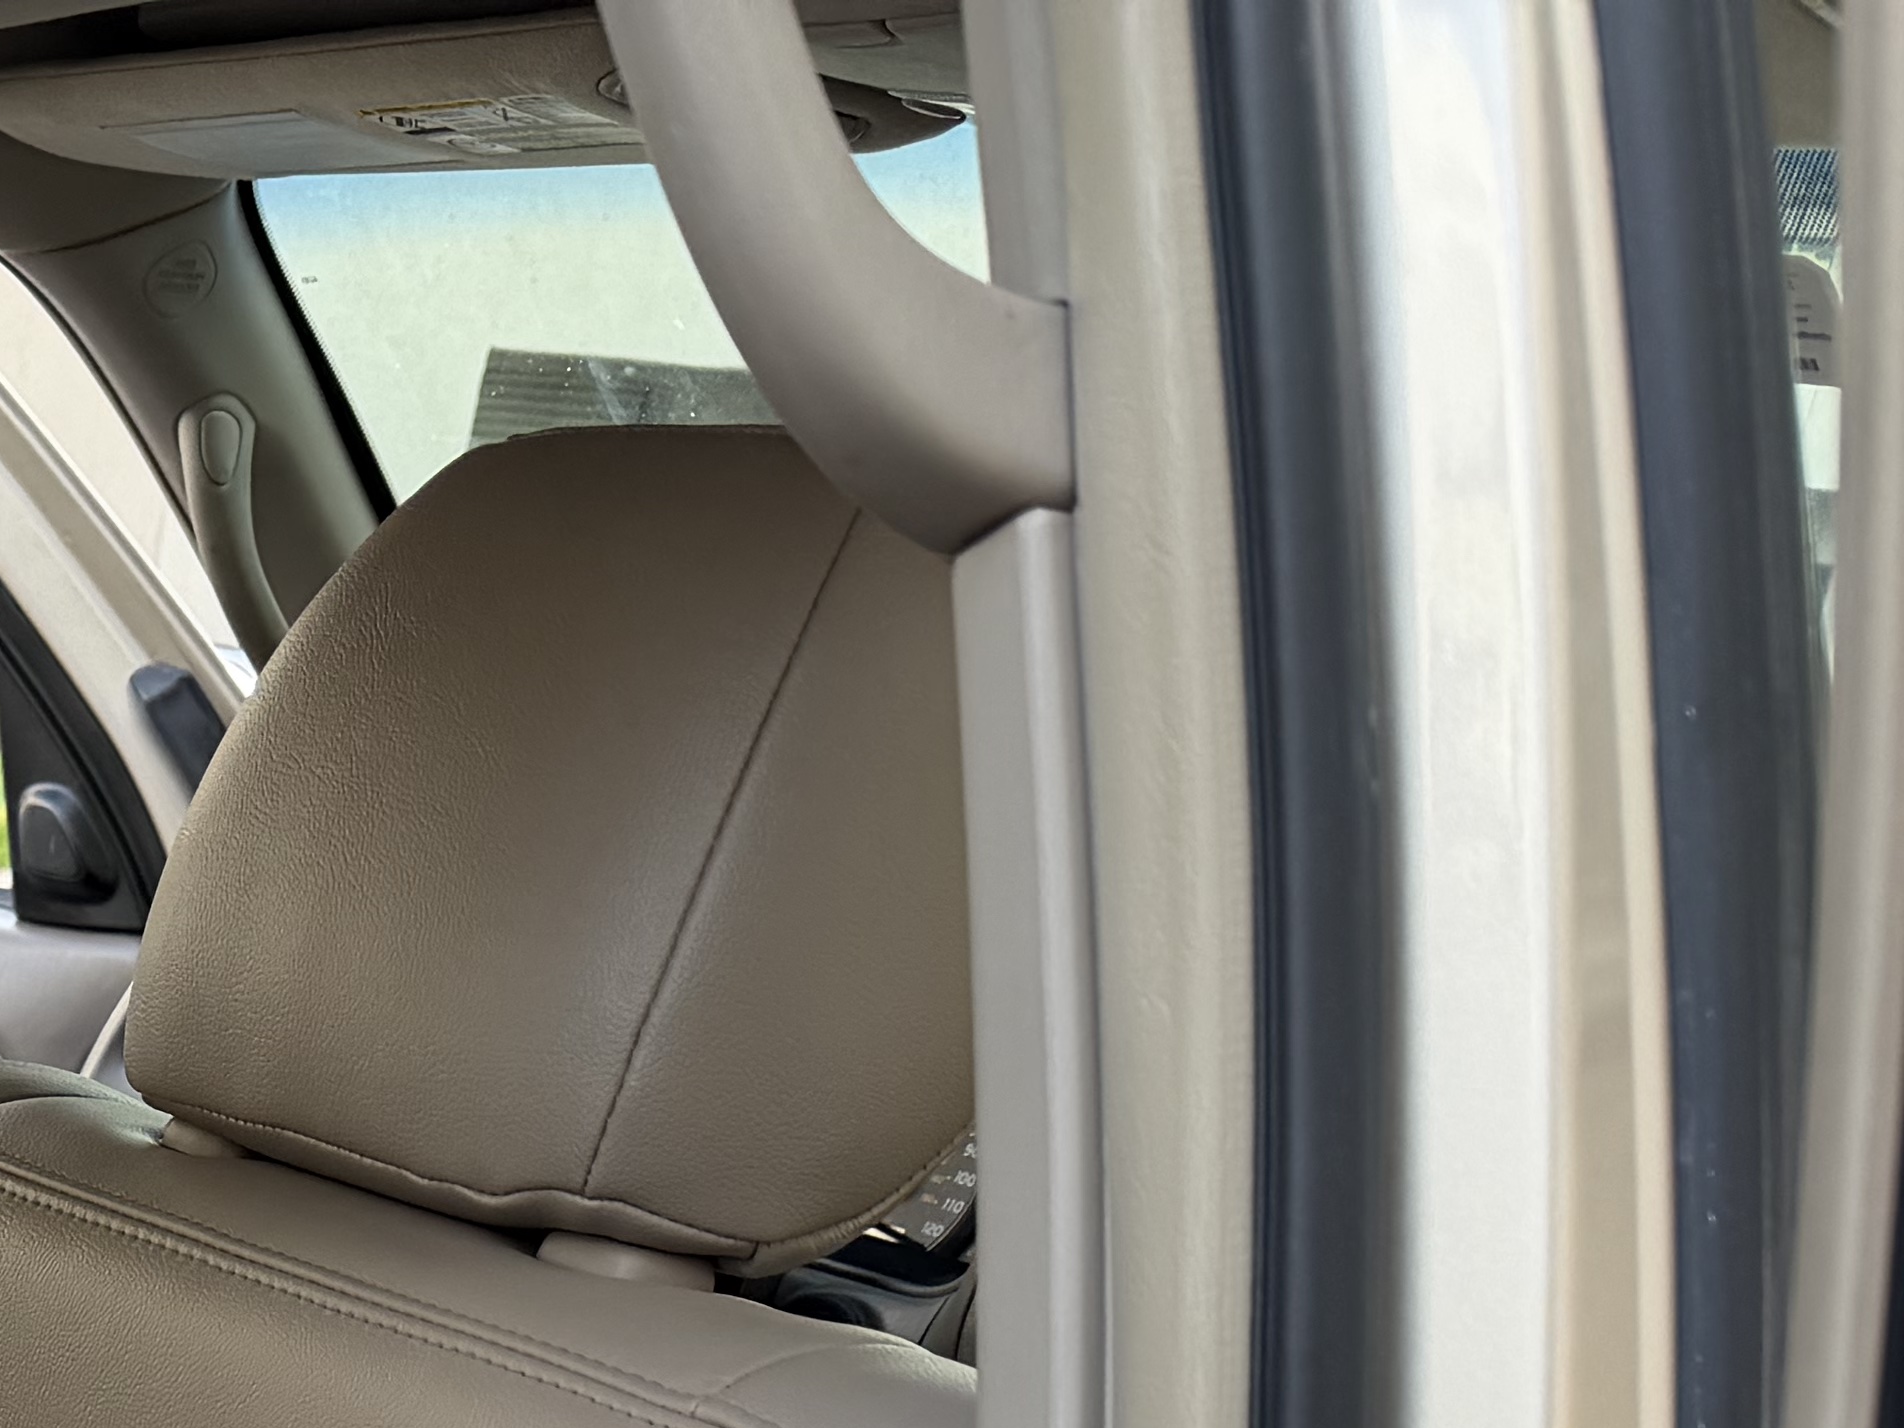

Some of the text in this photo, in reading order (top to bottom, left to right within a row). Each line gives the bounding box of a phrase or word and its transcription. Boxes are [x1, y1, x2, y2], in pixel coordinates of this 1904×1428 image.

[953, 1170, 976, 1187] 100
[941, 1198, 965, 1214] 110
[921, 1221, 944, 1237] 120
